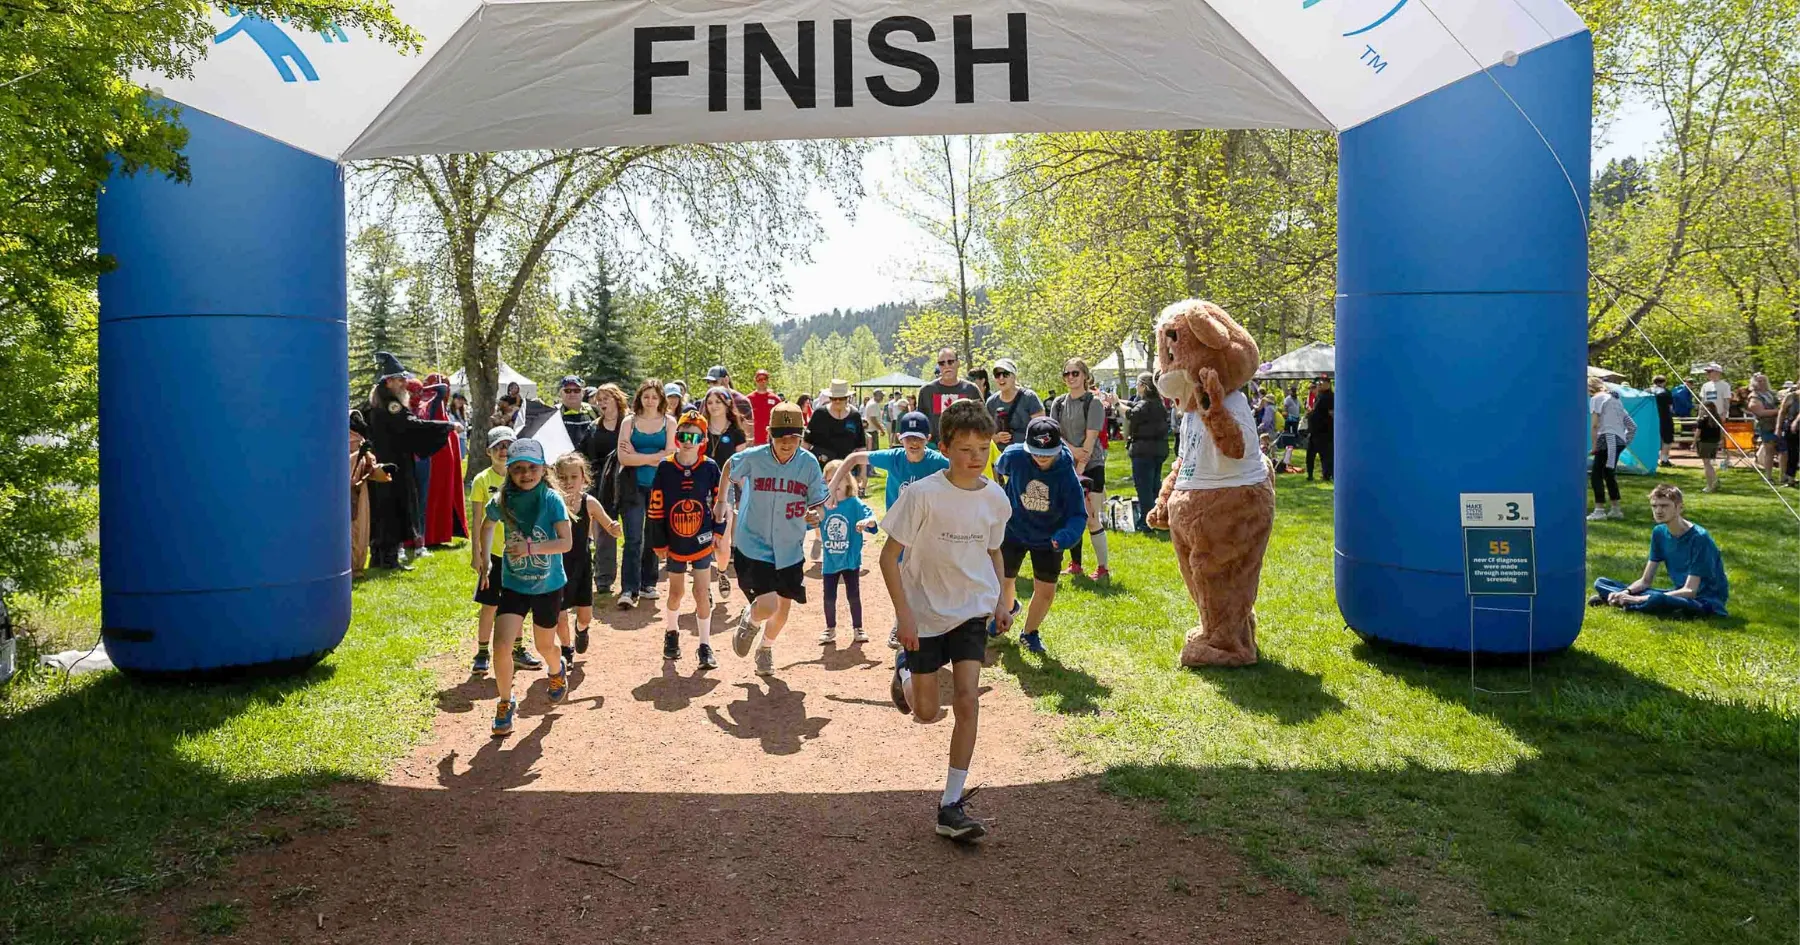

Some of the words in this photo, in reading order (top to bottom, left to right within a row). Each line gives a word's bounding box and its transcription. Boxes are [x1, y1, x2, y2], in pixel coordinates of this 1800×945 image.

[633, 12, 1029, 115] FINISH
[1360, 44, 1388, 74] TM
[754, 478, 808, 497] SWALLOWS
[785, 501, 806, 520] 55
[1506, 502, 1520, 521] 3
[673, 512, 701, 533] OILERS
[824, 540, 850, 550] CAMPS
[1489, 541, 1510, 555] 55
[1496, 557, 1528, 565] diagnoses
[1486, 576, 1517, 584] screening
